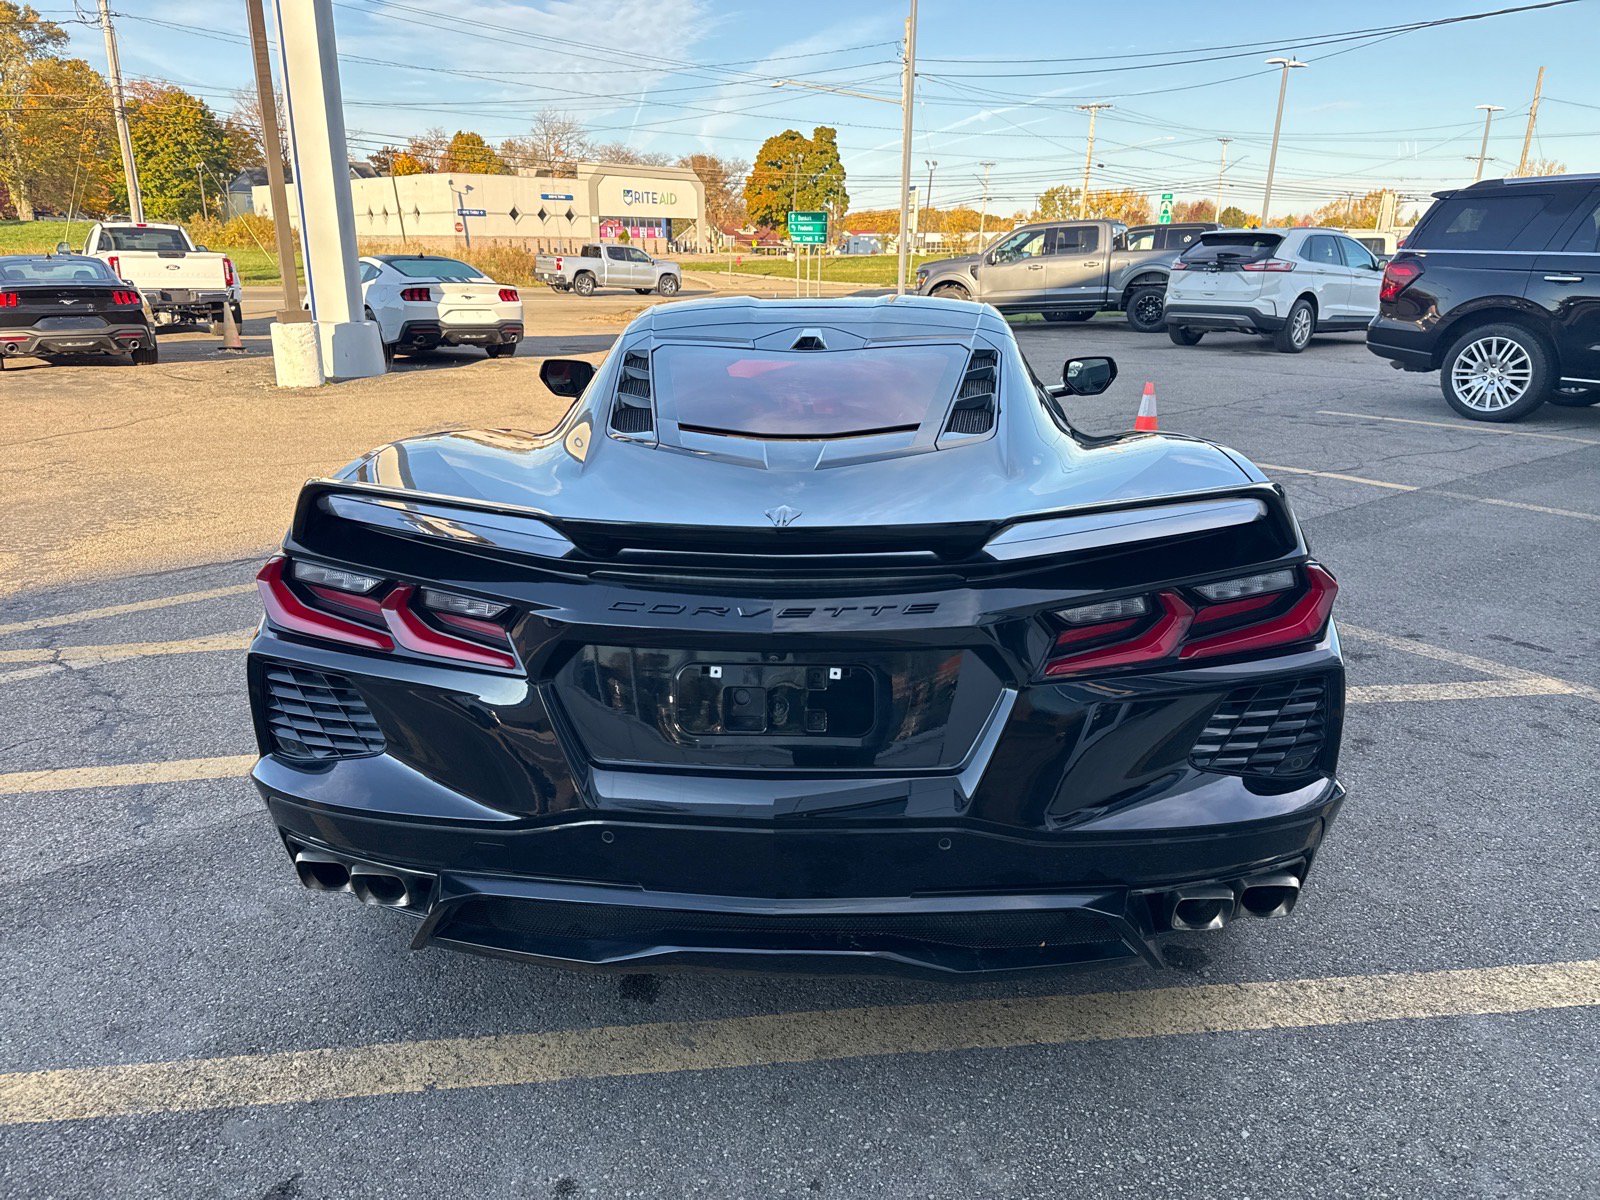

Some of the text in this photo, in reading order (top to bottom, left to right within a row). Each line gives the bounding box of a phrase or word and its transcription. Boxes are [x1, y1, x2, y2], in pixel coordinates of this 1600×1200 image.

[634, 190, 677, 205] RITE AID
[608, 601, 940, 619] CORVETTE
